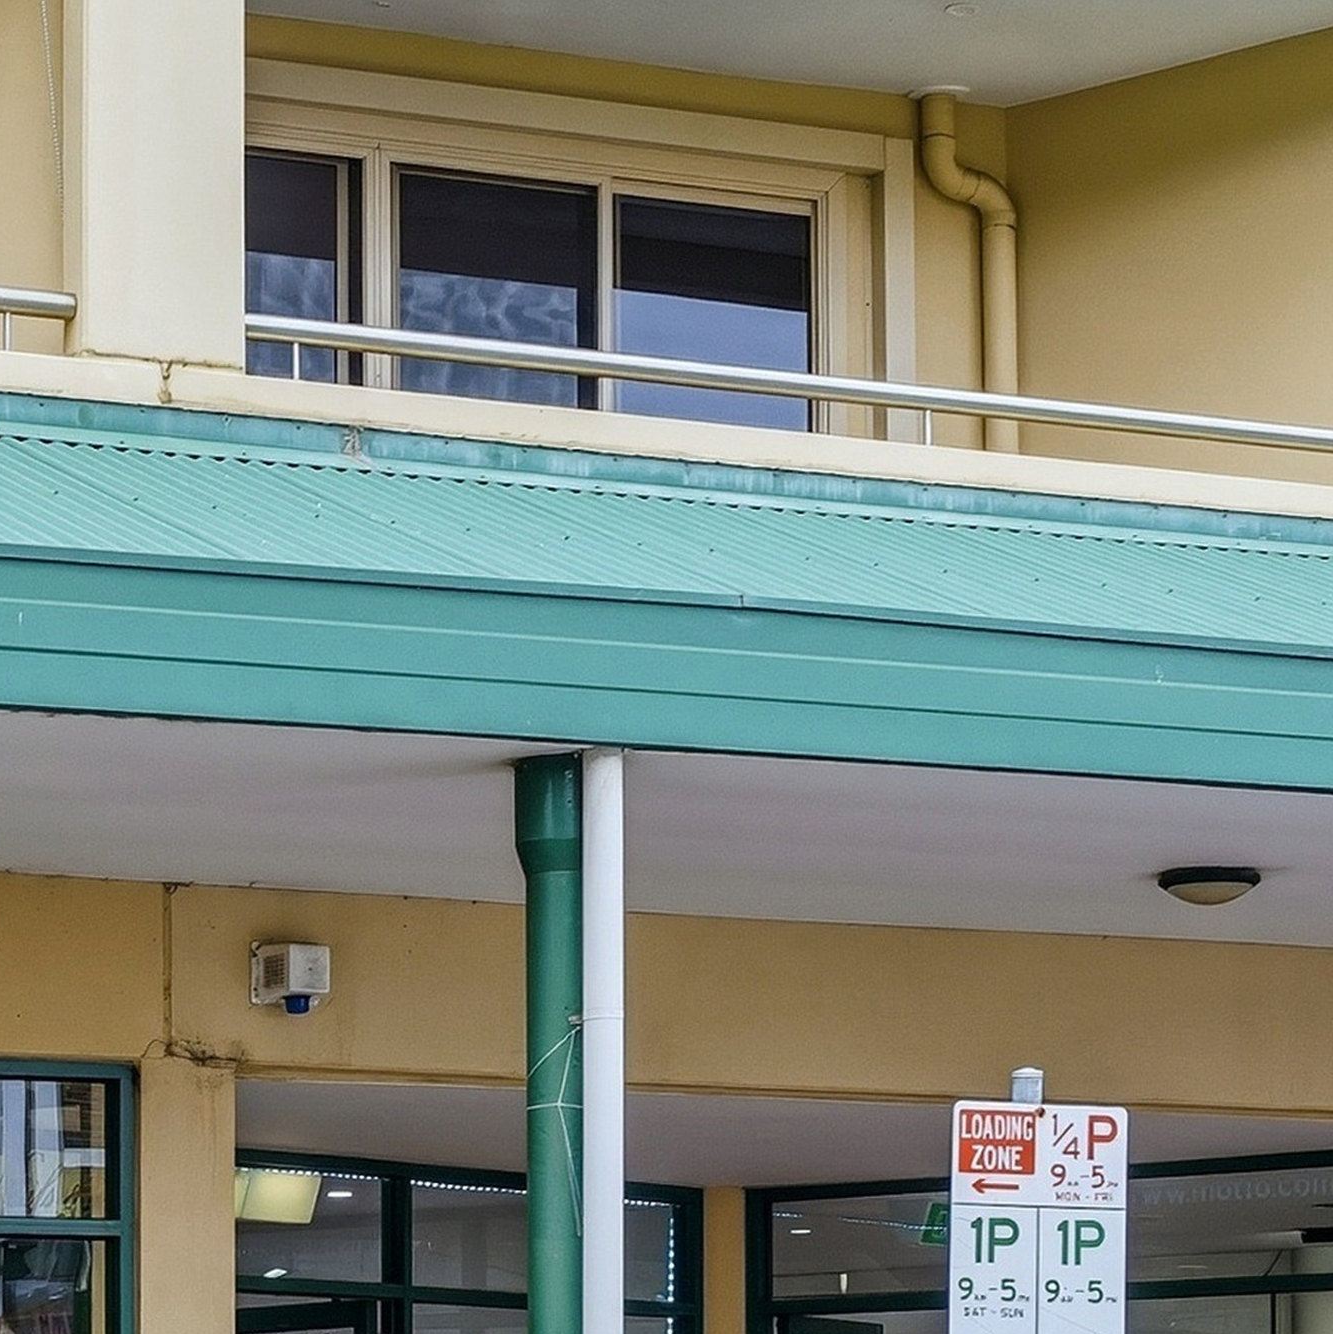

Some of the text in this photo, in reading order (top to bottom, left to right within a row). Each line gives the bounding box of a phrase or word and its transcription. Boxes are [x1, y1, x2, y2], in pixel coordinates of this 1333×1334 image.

[960, 1113, 1033, 1140] LOADING
[970, 1145, 1024, 1172] ZONE
[970, 1216, 1020, 1264] 1P
[1056, 1219, 1106, 1266] 1P
